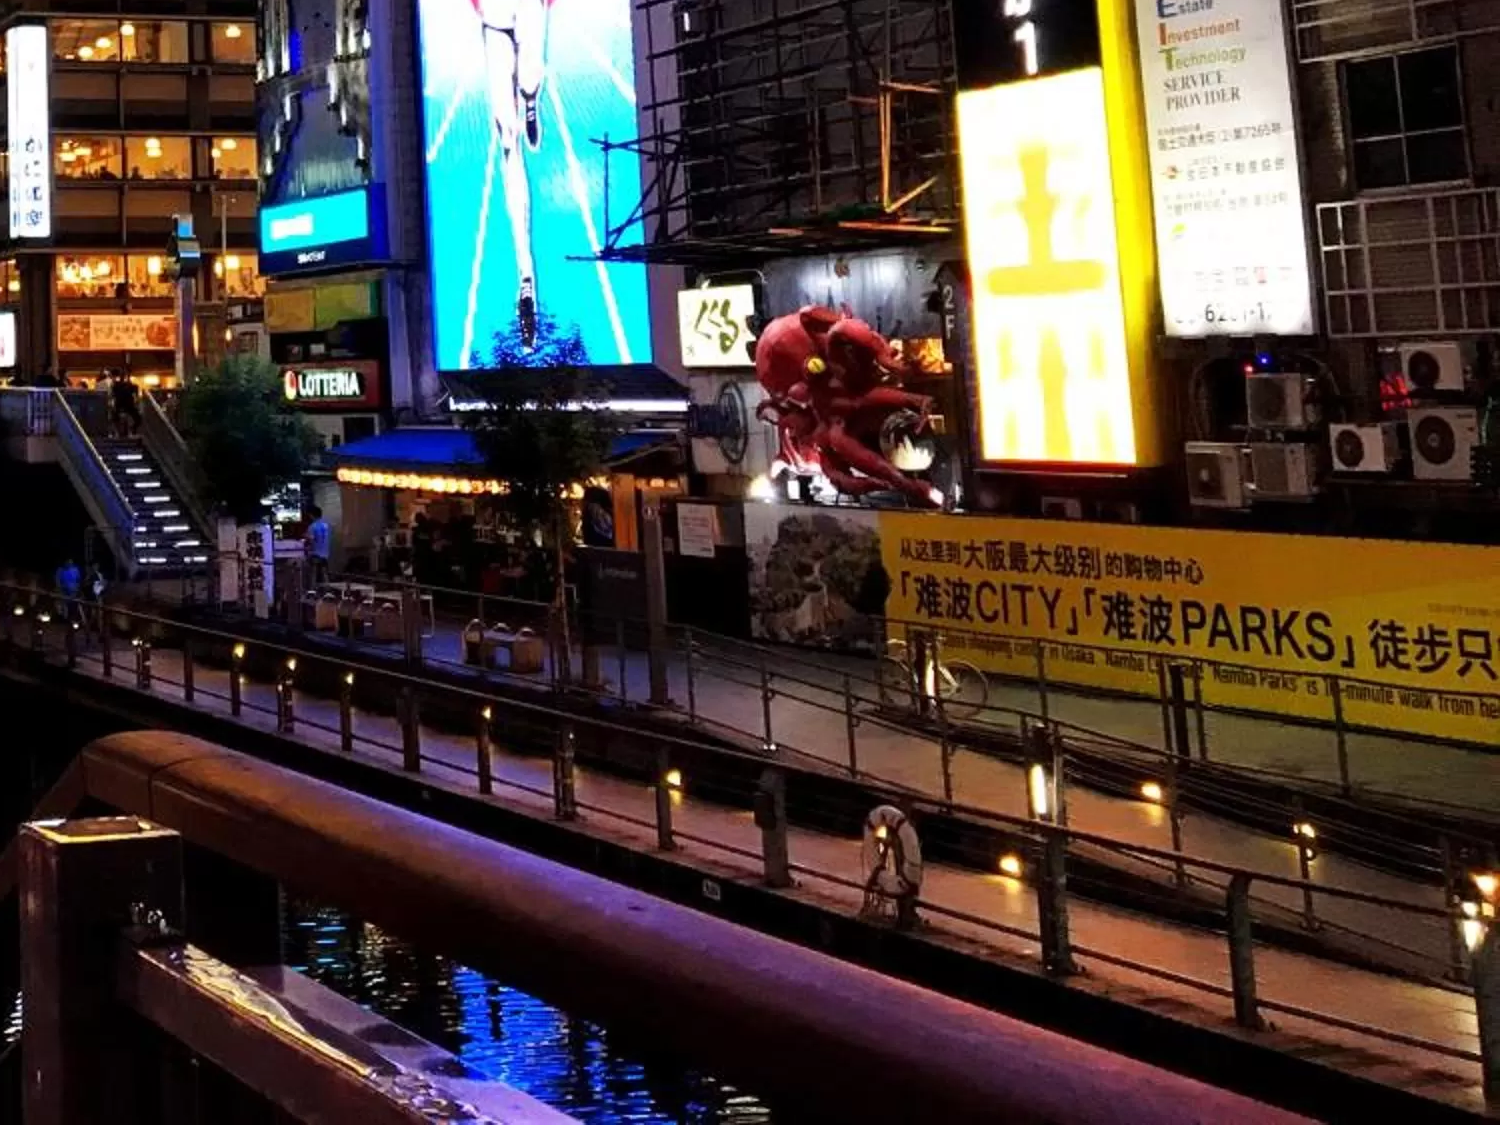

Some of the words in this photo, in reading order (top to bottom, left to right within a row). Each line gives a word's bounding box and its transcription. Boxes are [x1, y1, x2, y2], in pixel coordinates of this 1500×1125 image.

[1156, 18, 1241, 46] Investment
[1159, 45, 1247, 72] Technology
[1162, 70, 1226, 94] SERVICE
[1165, 86, 1242, 112] PROVIDER
[298, 369, 361, 398] LOTTERIA
[900, 538, 1205, 586] 从这里到大阪最大级别的购物中心
[901, 570, 1500, 682] 「难波CITY」「难波PARKS」徒步只
[1259, 670, 1297, 693] Parks
[1398, 685, 1435, 711] walk
[1438, 693, 1476, 718] from
